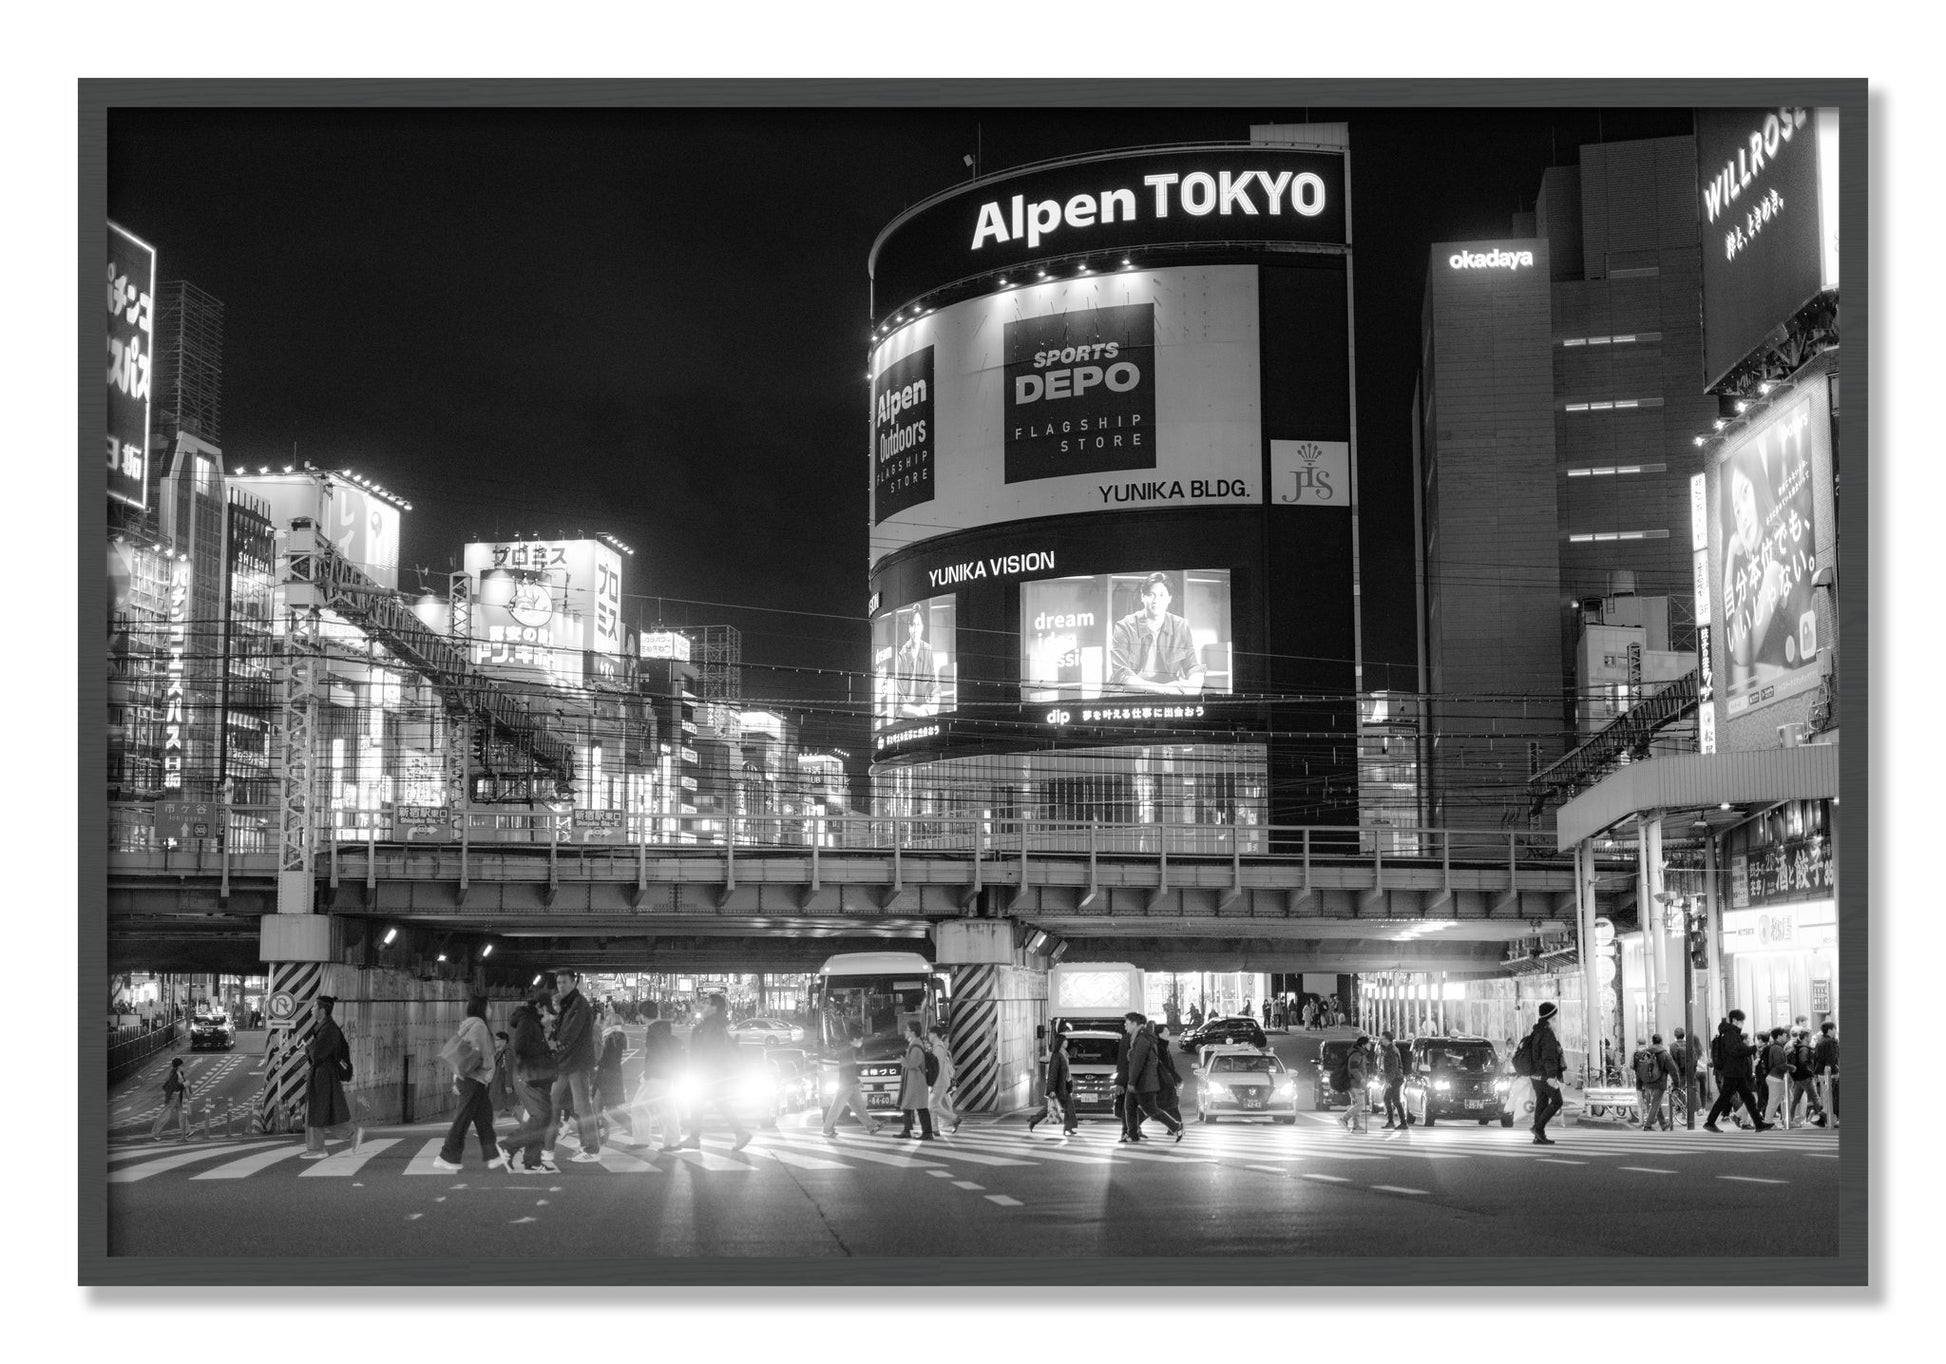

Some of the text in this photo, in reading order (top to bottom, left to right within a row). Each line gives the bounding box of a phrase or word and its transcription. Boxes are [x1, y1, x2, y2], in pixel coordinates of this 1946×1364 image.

[971, 171, 1326, 250] Alpen TOKYO
[1449, 248, 1534, 270] okadaya
[1033, 341, 1119, 368] SPORTS
[107, 335, 150, 401] スパス
[1015, 362, 1141, 405] DEPO
[877, 379, 926, 428] Alpen
[1015, 414, 1141, 440] FLAGSHIP
[880, 419, 926, 463] Outdoors
[1060, 434, 1142, 453] STORE
[876, 450, 927, 486] FLAGSHIP
[890, 468, 927, 493] STORE
[1099, 480, 1251, 503] YUNIKA BLDG.
[238, 551, 270, 574] SHISHA
[929, 551, 1055, 587] YUNIKA VISION
[1034, 612, 1095, 630] dream
[1047, 709, 1070, 725] dip
[1082, 706, 1204, 721] 夢を叶える仕事に出会おう
